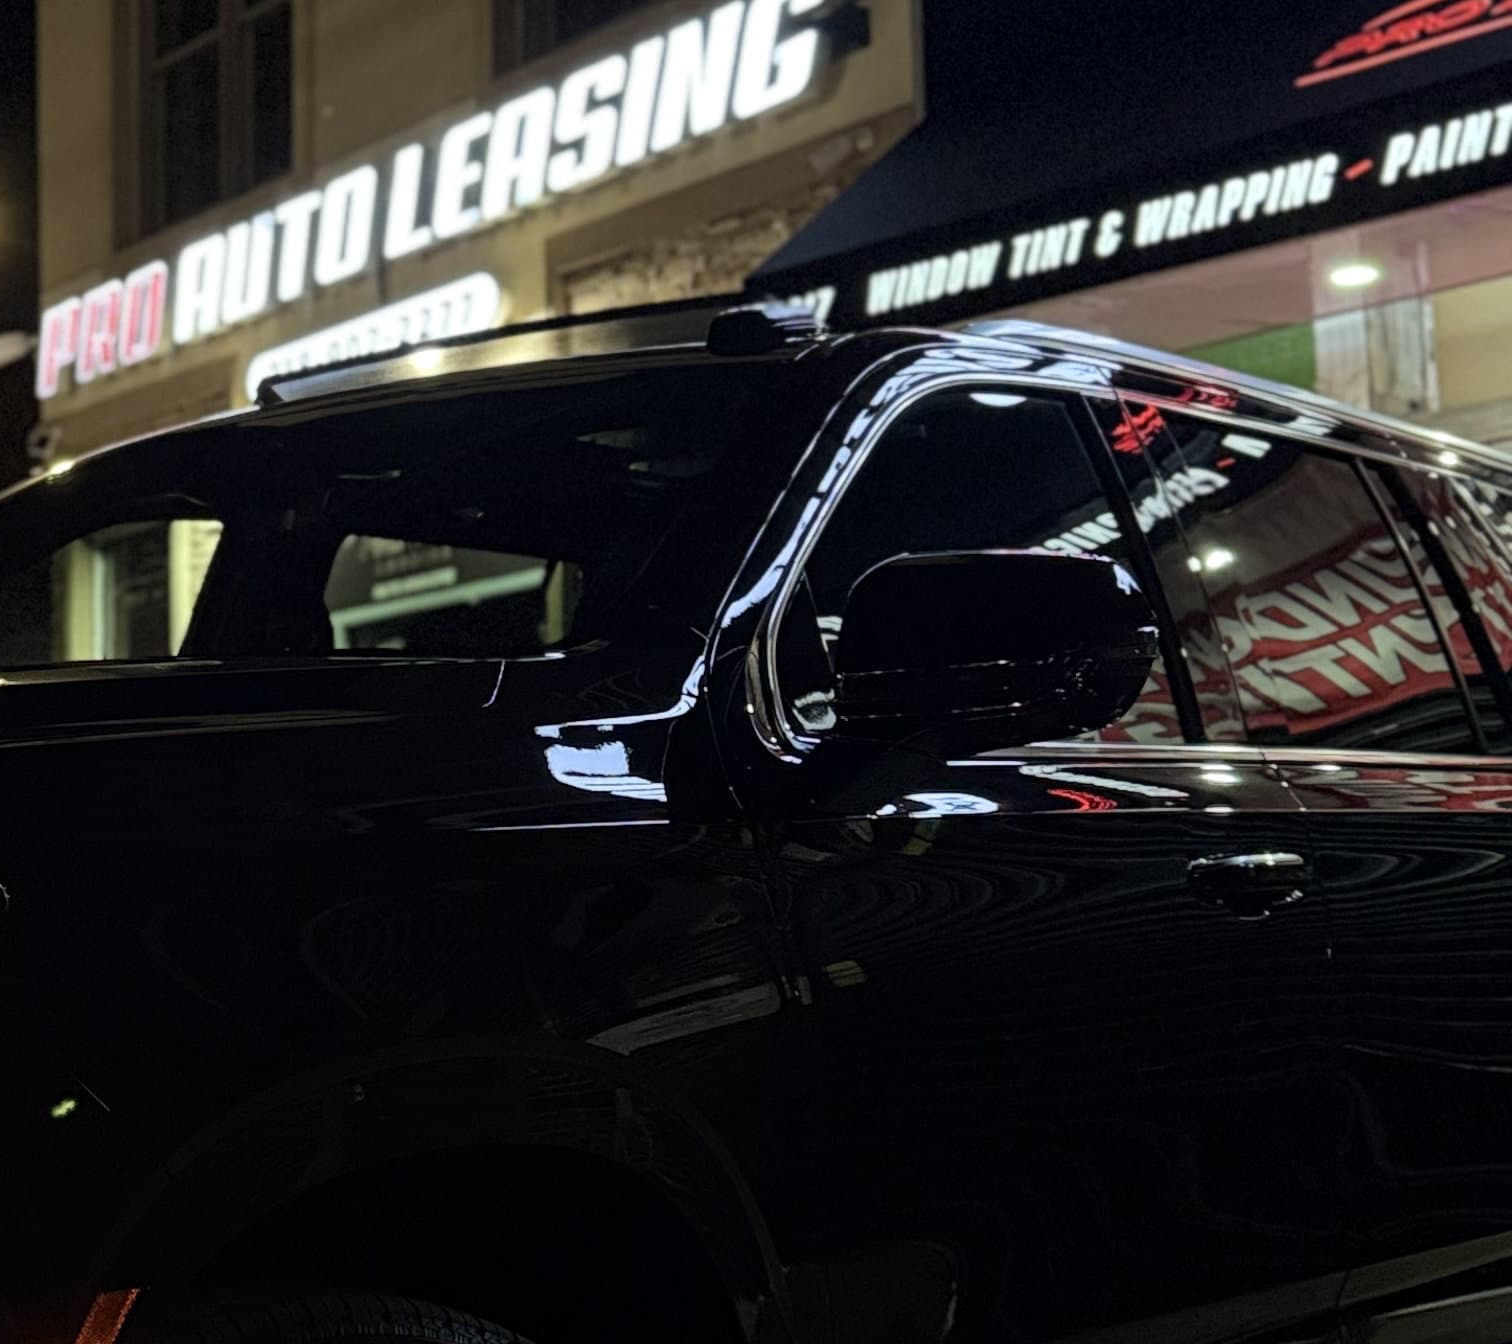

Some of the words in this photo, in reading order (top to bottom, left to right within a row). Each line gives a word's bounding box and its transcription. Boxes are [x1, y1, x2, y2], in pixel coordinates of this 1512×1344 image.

[36, 259, 169, 401] PRO
[173, 164, 378, 345] AUTO
[865, 241, 1003, 317] WINDOW
[1007, 217, 1092, 280] TINT
[1093, 209, 1125, 259] &
[1134, 152, 1340, 249] WRAPPING
